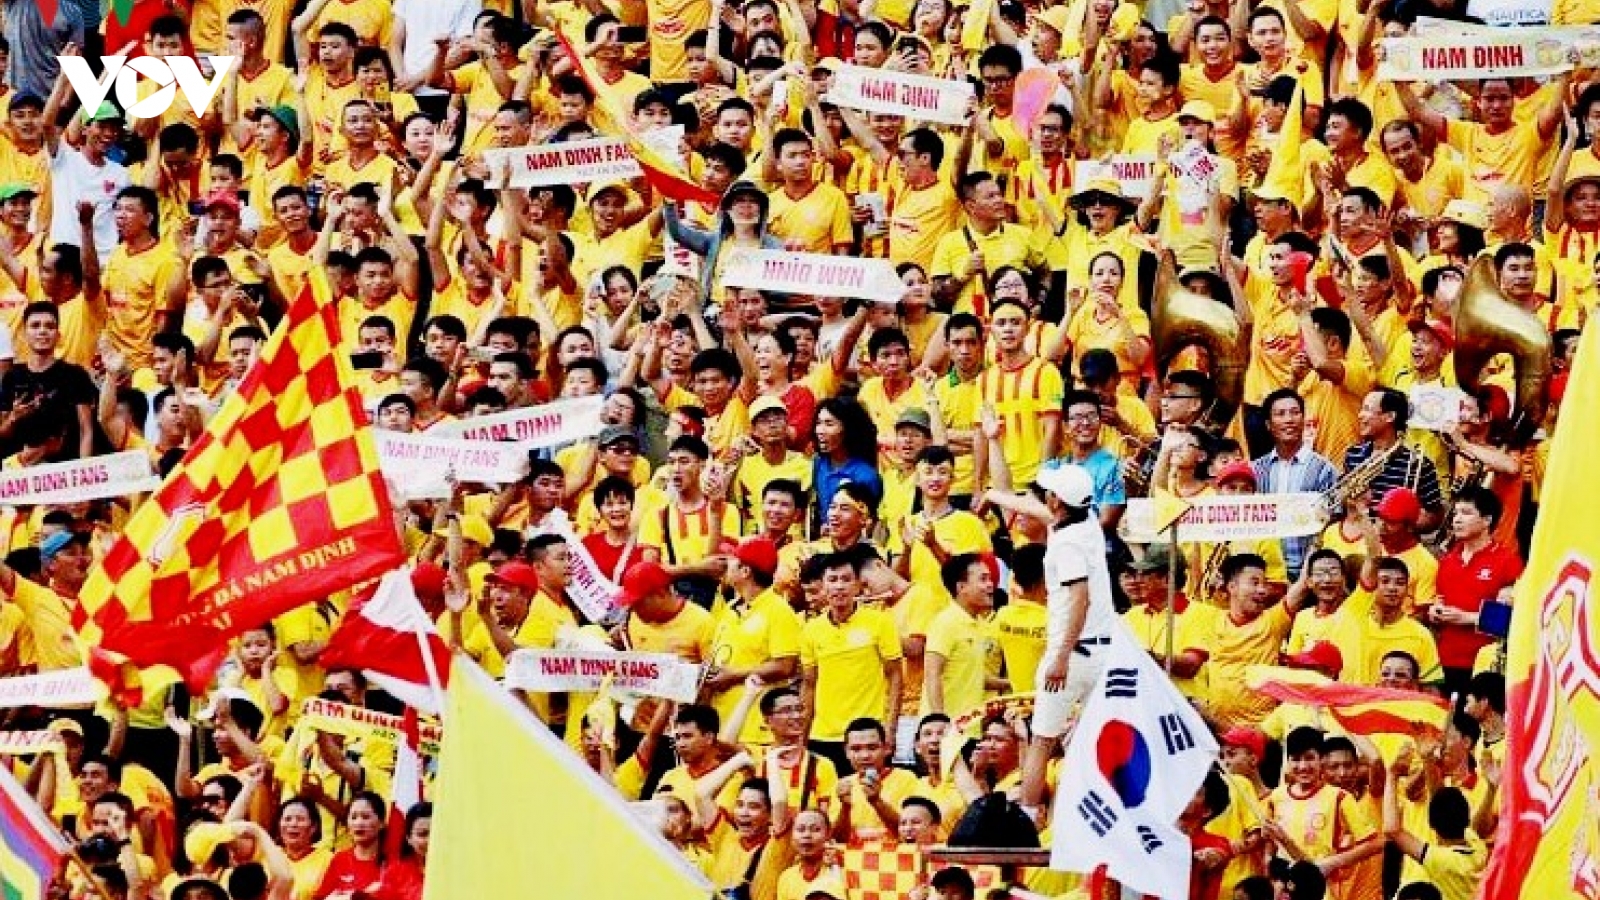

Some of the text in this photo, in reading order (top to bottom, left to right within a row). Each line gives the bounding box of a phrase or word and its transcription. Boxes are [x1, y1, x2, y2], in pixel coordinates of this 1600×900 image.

[1422, 47, 1467, 69] NAM
[860, 77, 897, 103] NAM
[526, 151, 563, 170] NAM
[817, 263, 865, 287] NAM
[71, 464, 108, 487] FANS
[1243, 503, 1277, 522] FANS
[244, 559, 297, 591] NAM
[540, 656, 577, 676] NAM
[620, 659, 660, 680] FANS
